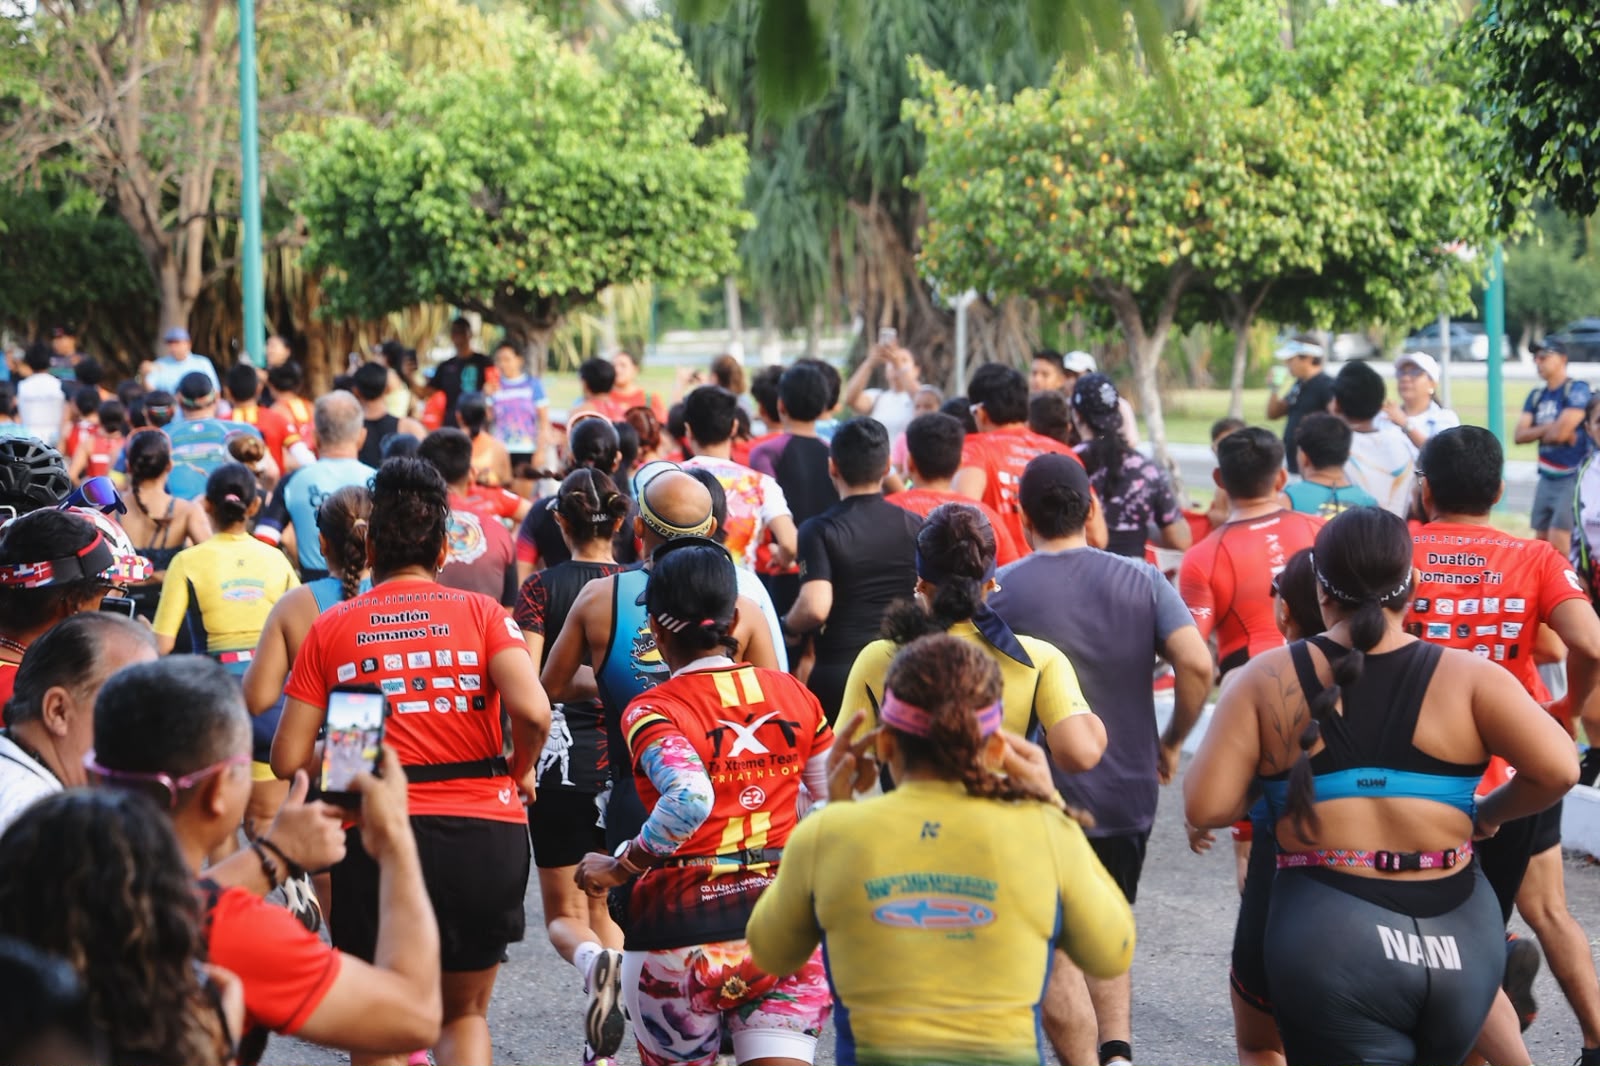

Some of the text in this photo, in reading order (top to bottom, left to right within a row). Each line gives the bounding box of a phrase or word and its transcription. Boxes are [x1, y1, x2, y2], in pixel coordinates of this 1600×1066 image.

[1427, 552, 1486, 566] Duatlón
[1483, 570, 1502, 584] Tri
[370, 609, 430, 626] Duatlón
[356, 624, 450, 647] Romanos Tri
[725, 758, 765, 771] Xtreme
[710, 765, 799, 783] TRIATHLON
[1376, 924, 1462, 970] NANI
